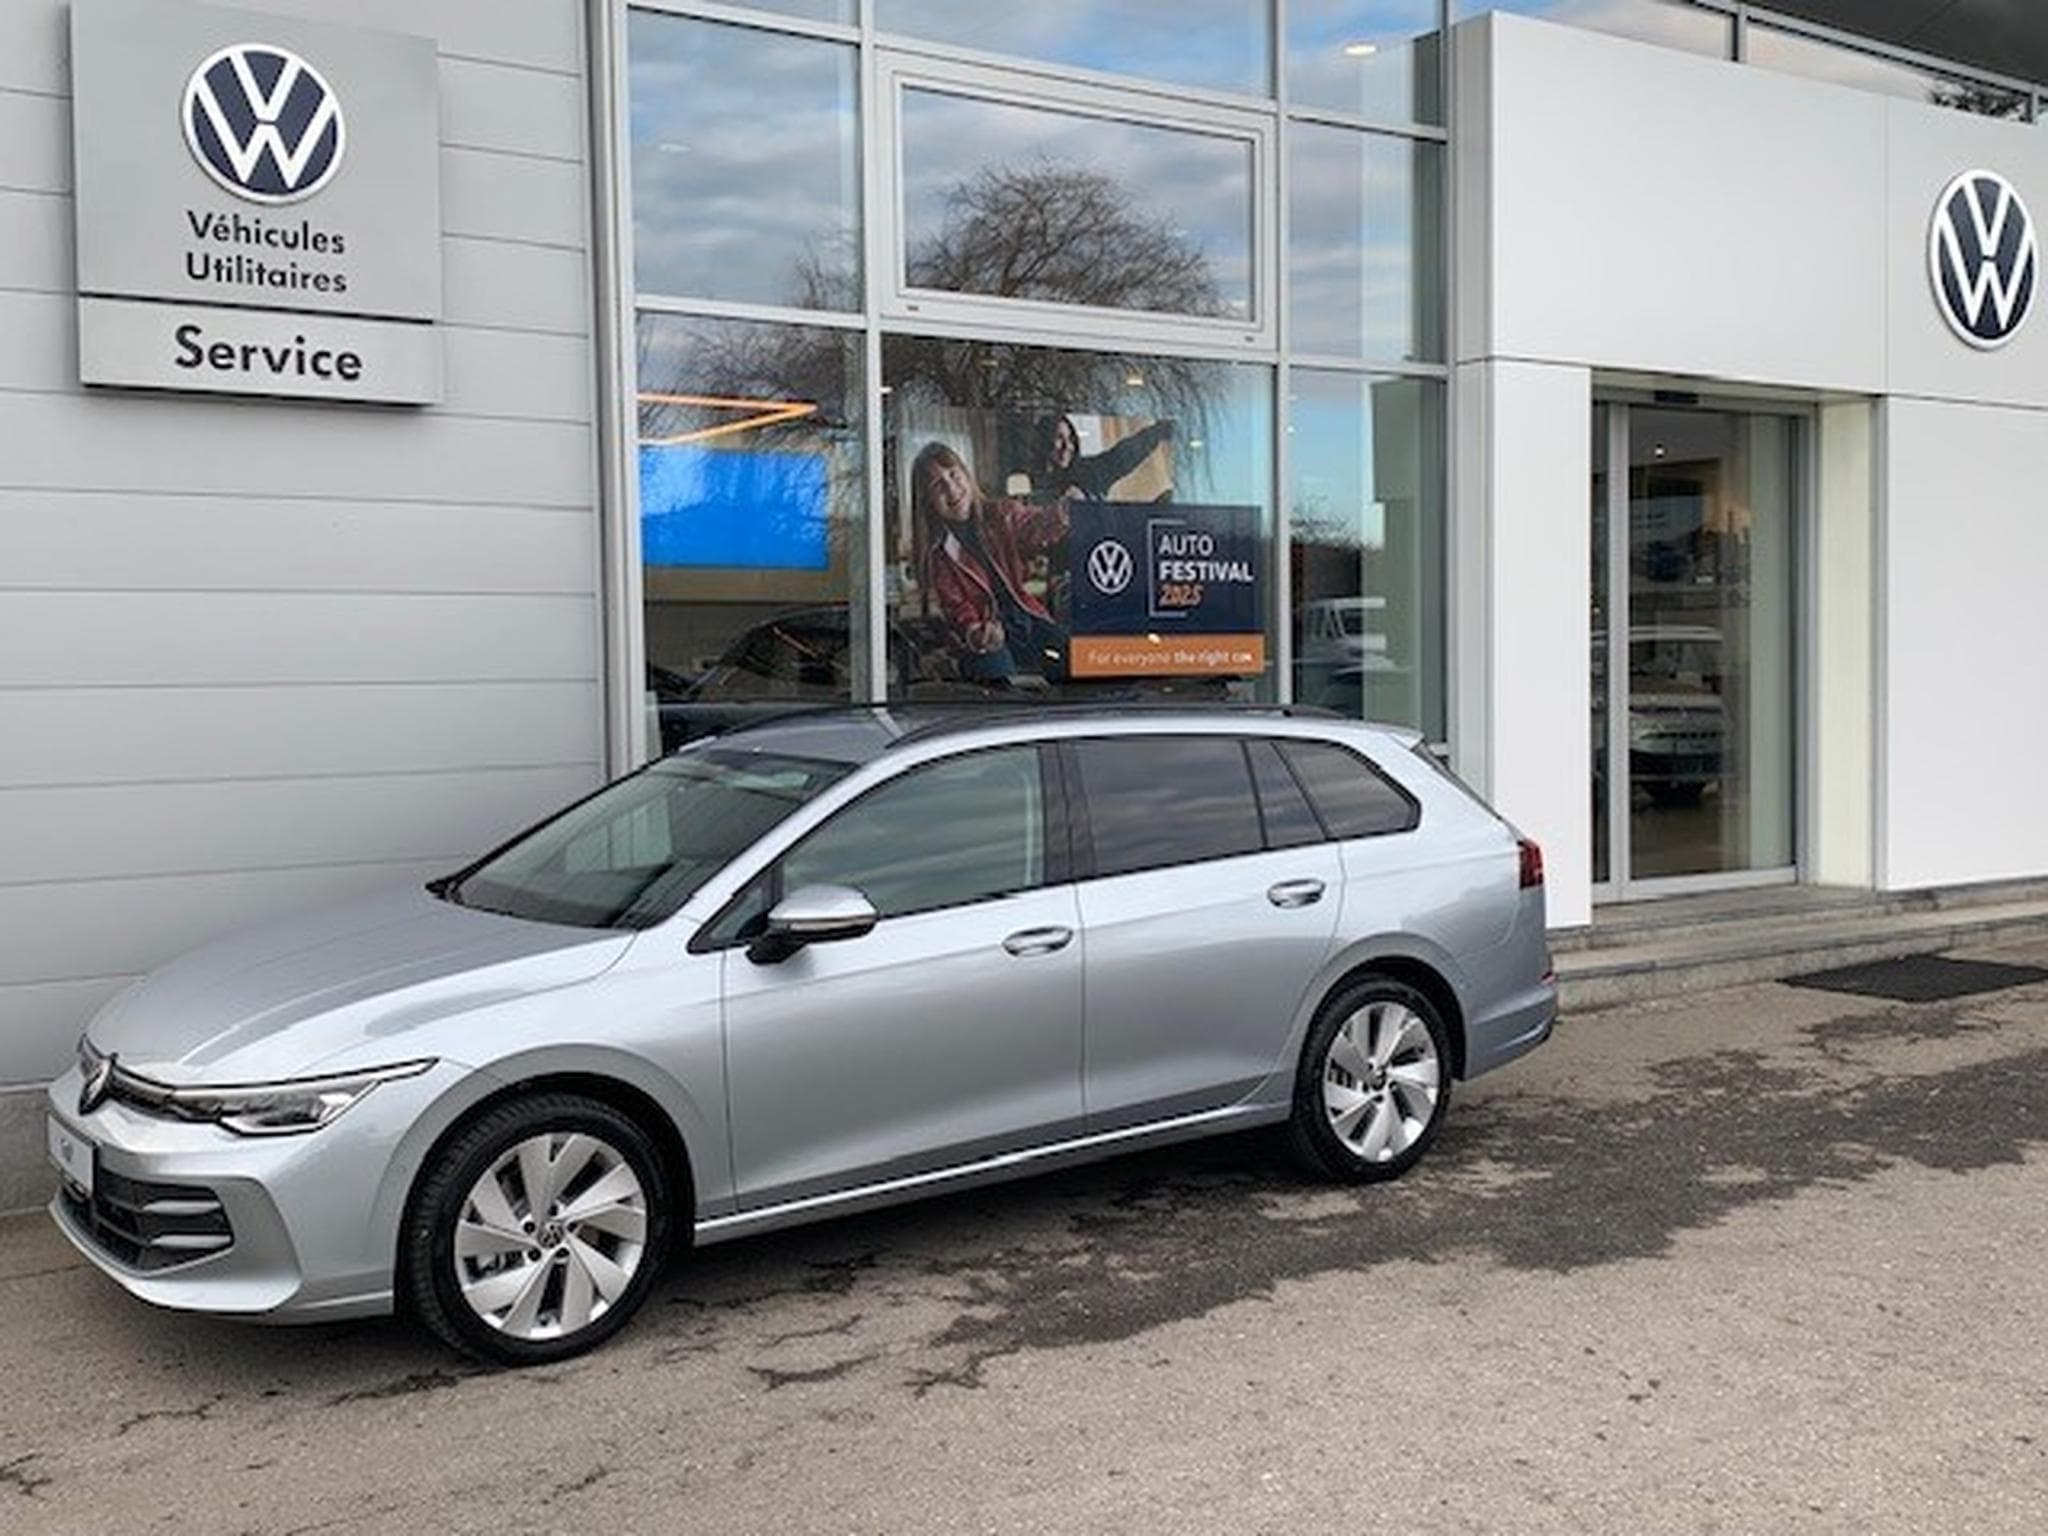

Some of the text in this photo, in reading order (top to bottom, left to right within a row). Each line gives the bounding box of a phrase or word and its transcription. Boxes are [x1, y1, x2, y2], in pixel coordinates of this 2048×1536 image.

[186, 210, 345, 254] Véhicules
[186, 251, 347, 292] Utilitaires
[174, 324, 363, 380] Service
[1159, 534, 1214, 557] AUTO
[1159, 561, 1255, 582] FESTIVAL
[1159, 583, 1204, 606] 2025
